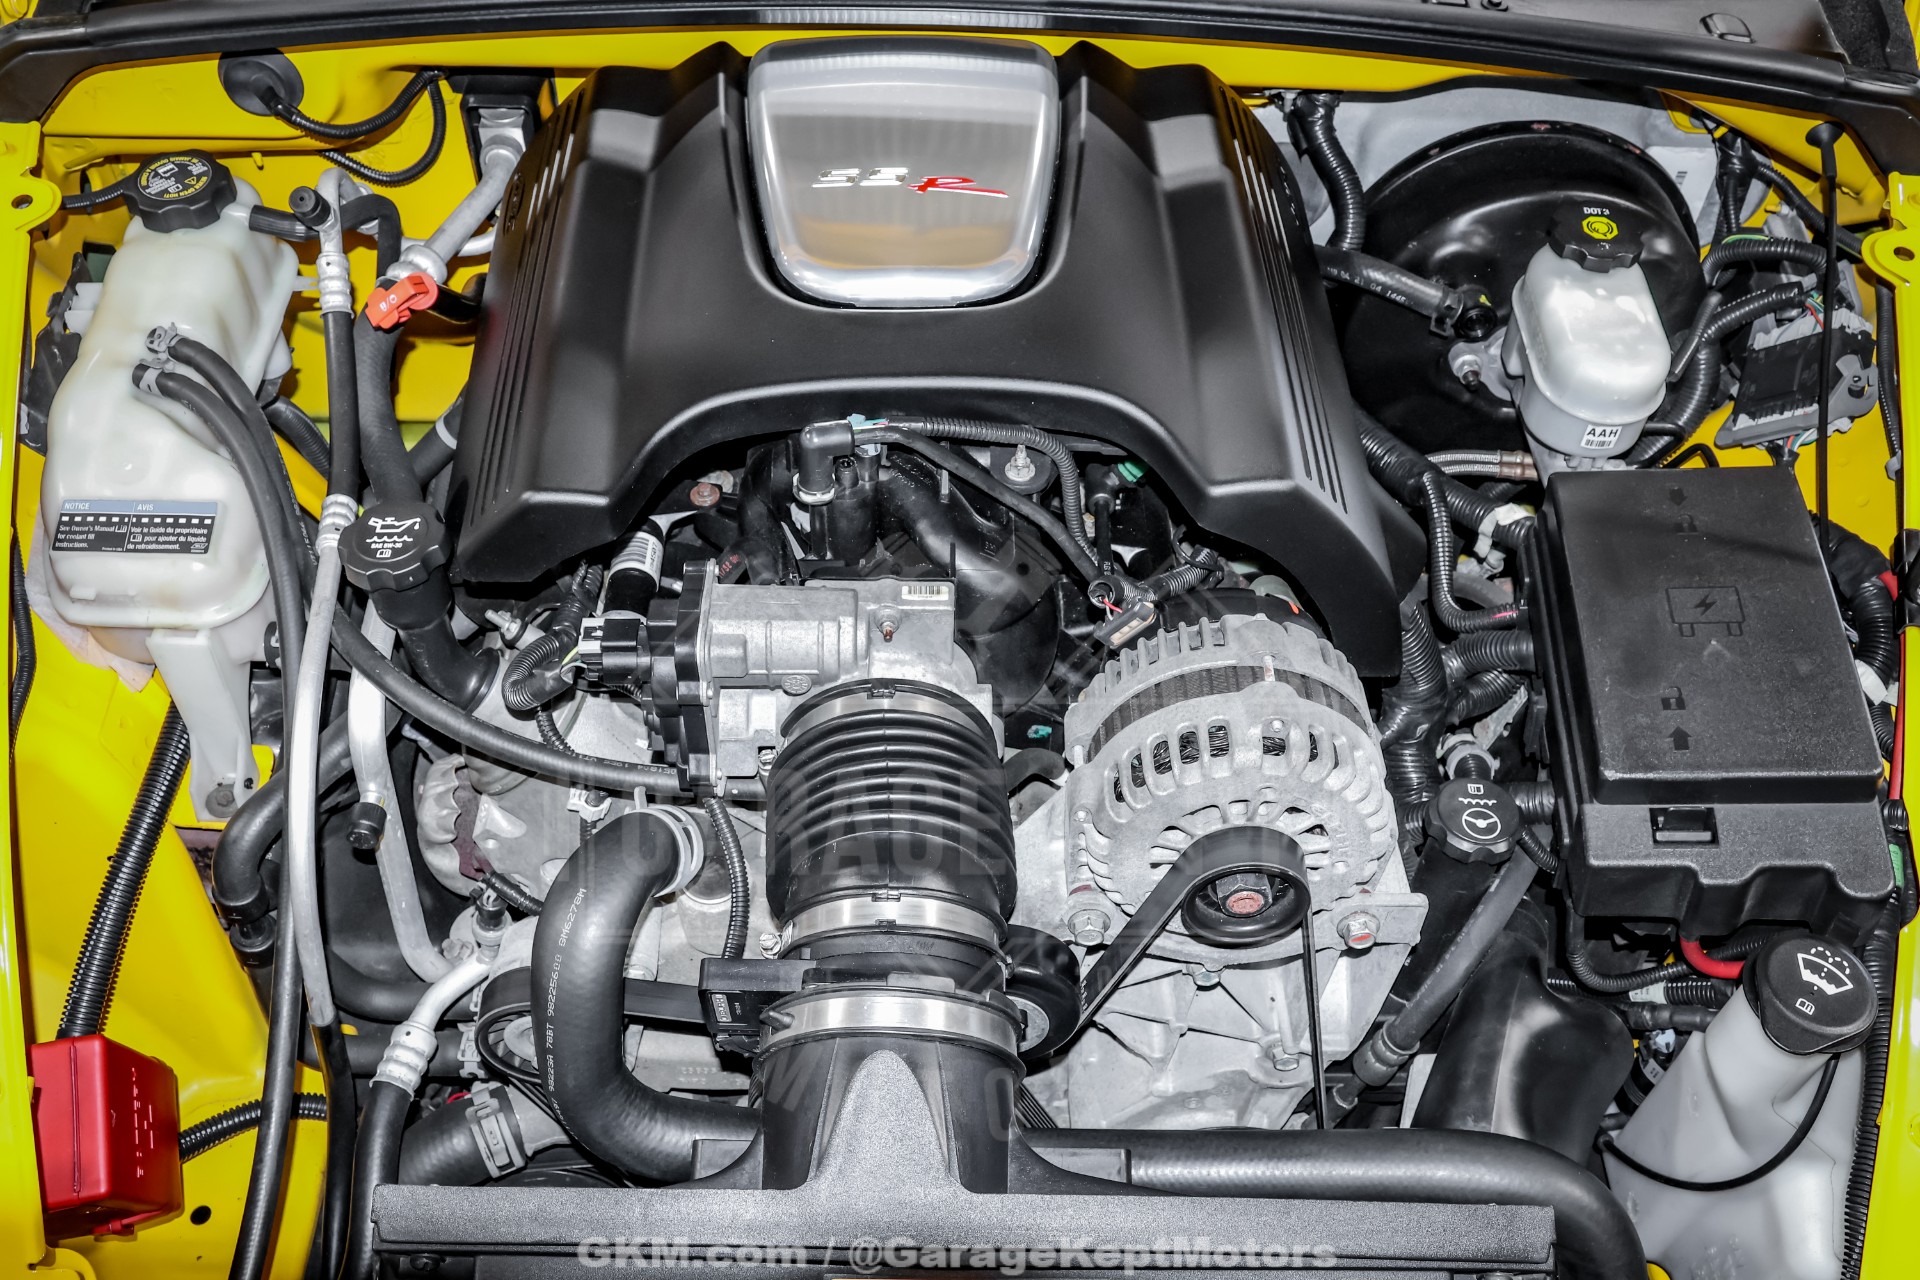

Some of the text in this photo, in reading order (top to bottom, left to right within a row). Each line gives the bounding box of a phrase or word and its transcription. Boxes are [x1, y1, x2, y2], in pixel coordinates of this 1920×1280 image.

[811, 167, 1009, 199] SSR
[180, 187, 195, 196] OPEN
[1586, 428, 1619, 437] AAH
[64, 502, 154, 511] NOTICE AVIS
[174, 527, 208, 535] propriétaire
[157, 534, 178, 543] ajouter
[186, 535, 207, 543] liquide
